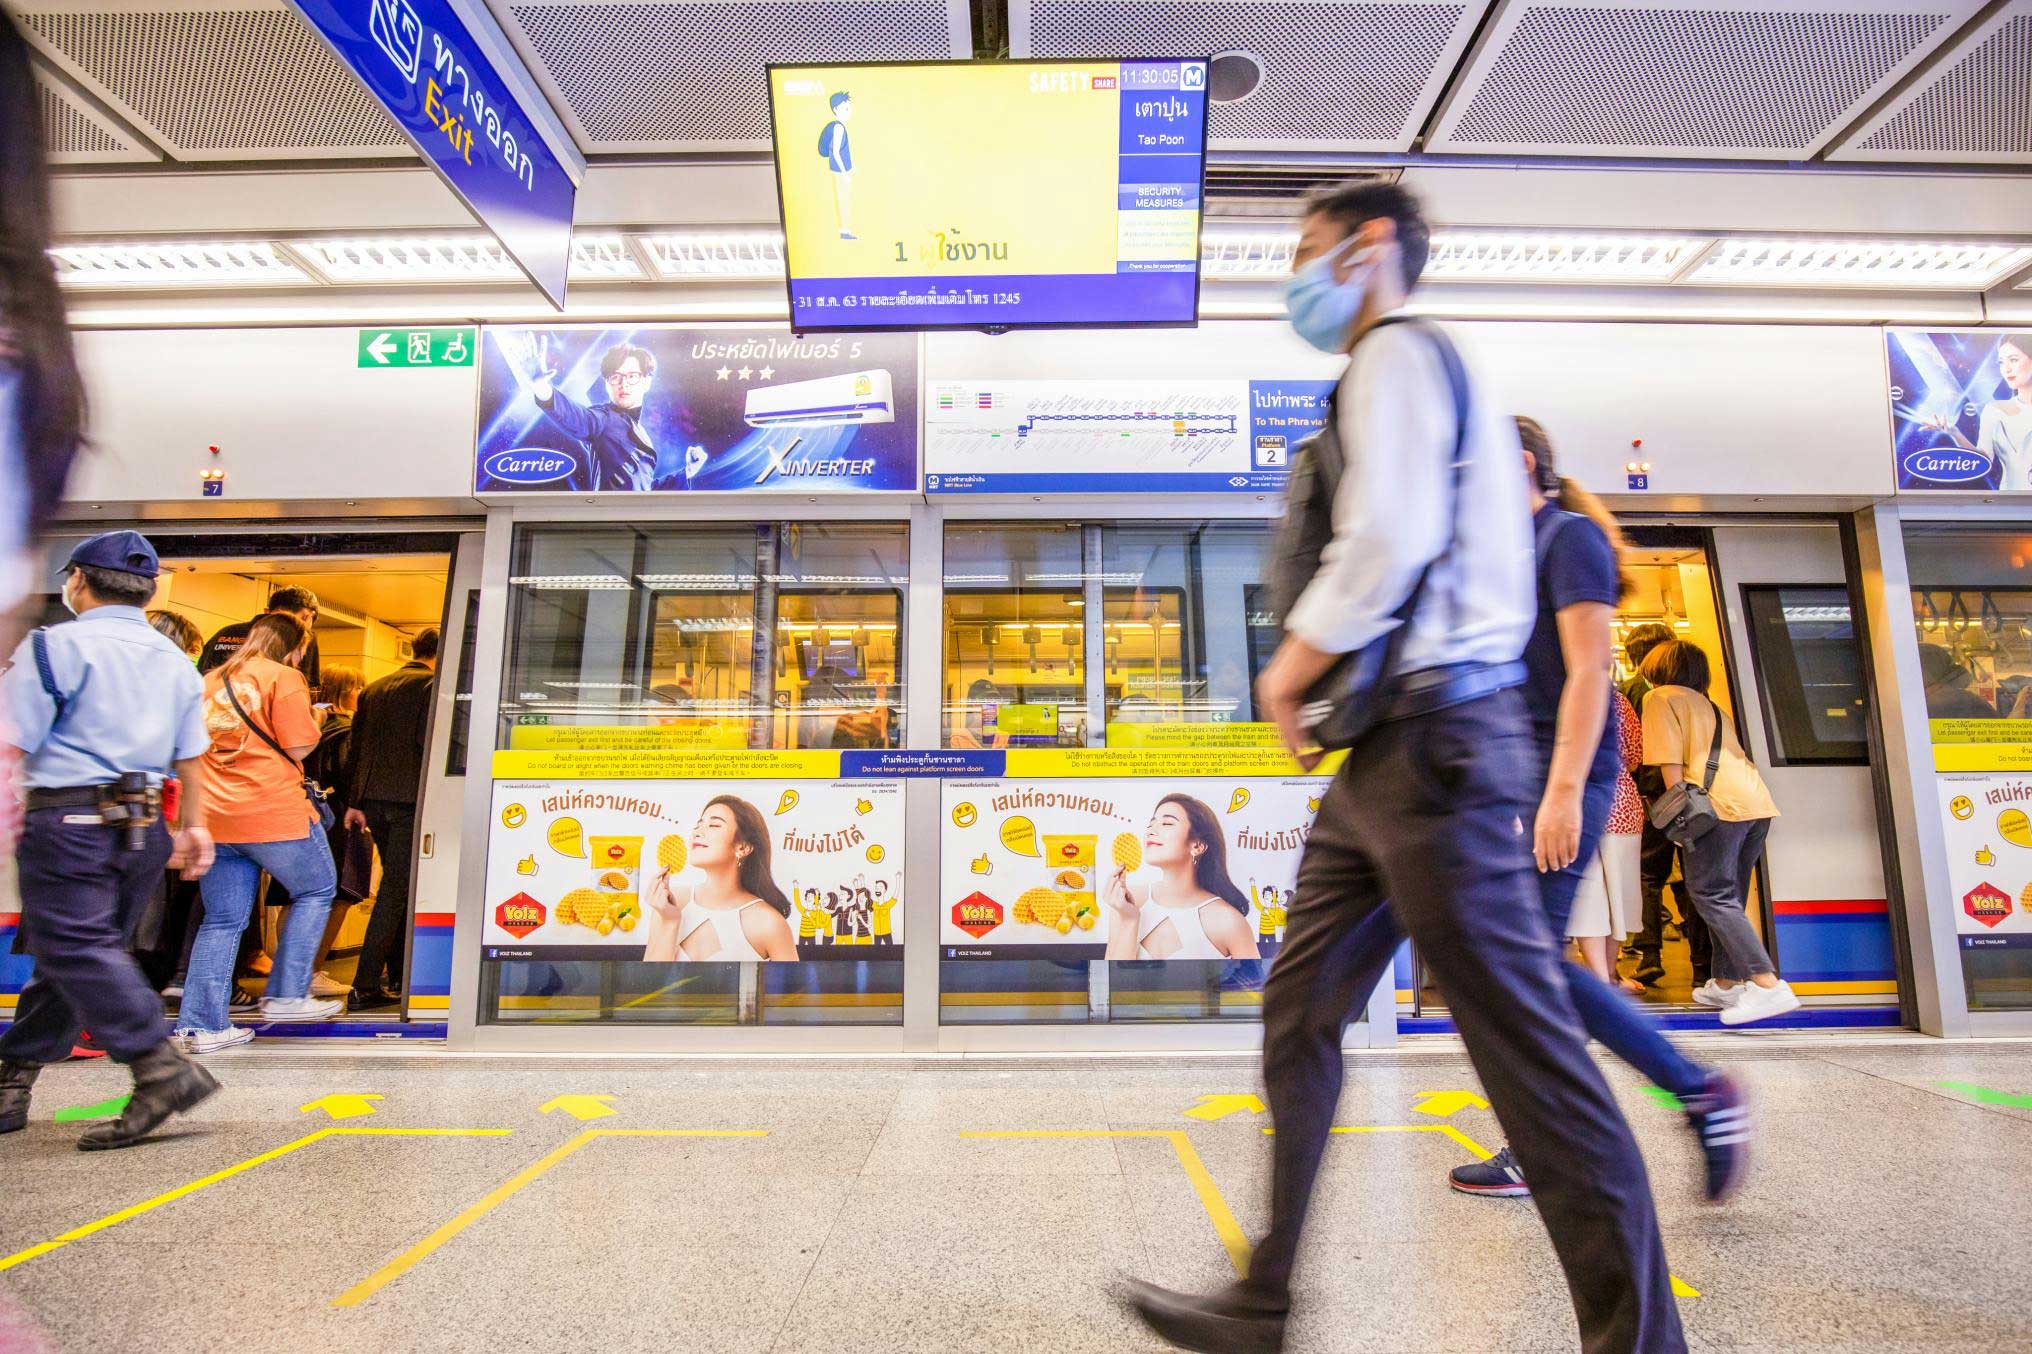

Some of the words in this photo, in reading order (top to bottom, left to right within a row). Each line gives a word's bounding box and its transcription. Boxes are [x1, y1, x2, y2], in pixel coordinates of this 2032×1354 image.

[1029, 71, 1089, 93] SAFETY
[1094, 78, 1115, 89] SHARE
[1122, 69, 1178, 84] 11:30:05
[433, 33, 534, 192] ทางออก
[1135, 95, 1189, 122] เตาปูน
[424, 77, 474, 166] Exit
[1138, 134, 1157, 145] Tao
[1159, 134, 1184, 145] Poon
[1138, 187, 1182, 196] SECURITY
[1135, 198, 1184, 208] MEASURES
[895, 241, 908, 262] 1
[798, 296, 812, 308] 31
[843, 294, 857, 306] 63
[965, 289, 989, 305] โทร
[993, 292, 1020, 306] 1245
[691, 338, 841, 360] ประหยัดไฟเบอร์
[850, 342, 863, 359] 5
[1252, 389, 1316, 408] ไปท่าพระ
[1255, 417, 1267, 426] To
[1268, 417, 1286, 426] Tha
[1287, 417, 1309, 426] Phra
[1310, 418, 1322, 426] via
[497, 456, 565, 472] Carrier
[1266, 450, 1276, 463] 2
[1916, 455, 1980, 471] Carrier
[212, 484, 219, 494] 7
[1637, 477, 1644, 488] 8
[575, 762, 592, 771] alight
[640, 762, 664, 771] warning
[714, 762, 730, 771] given
[881, 752, 965, 766] ห้ามพิงประตูกั้นชานชาลา
[541, 788, 680, 825] เสน่ห์ความหอม...
[991, 787, 1132, 823] เสน่ห์ความหอม...
[782, 823, 865, 854] ที่แบ่งไม่ได้
[1971, 894, 2005, 910] Voiz
[503, 904, 539, 921] Voiz
[959, 903, 995, 920] Voiz
